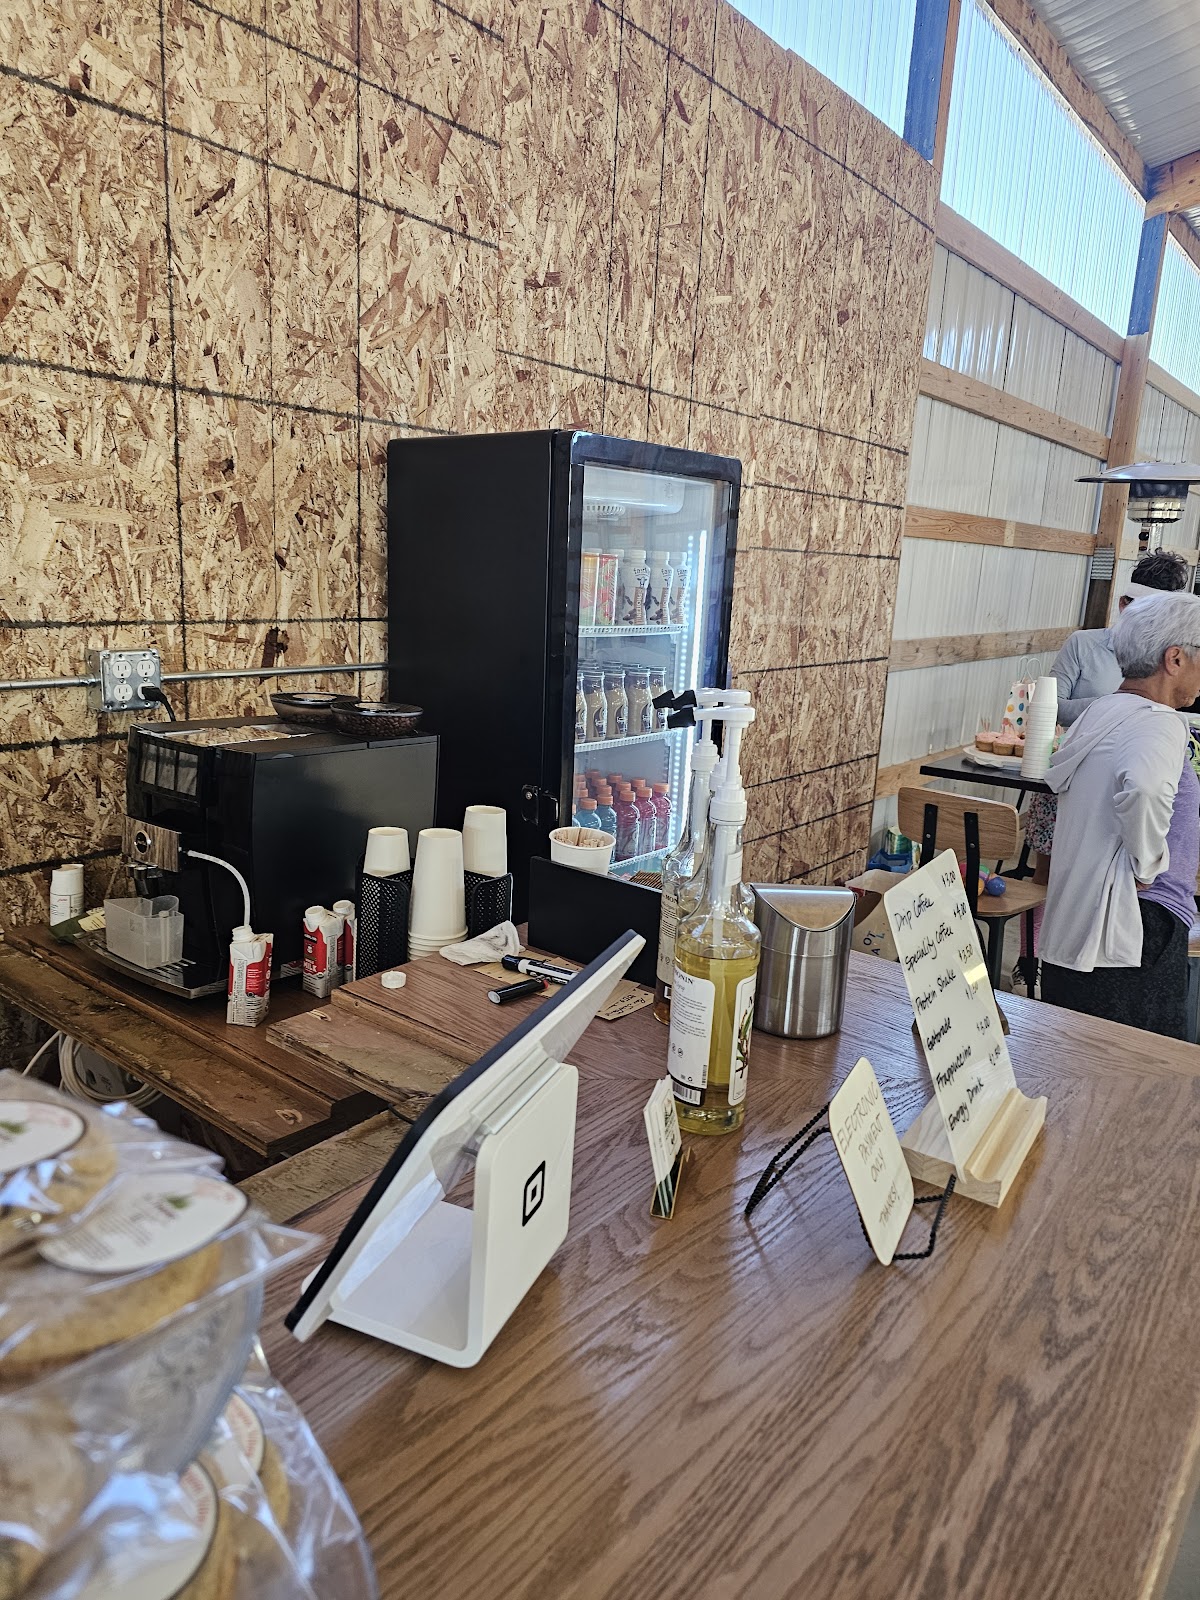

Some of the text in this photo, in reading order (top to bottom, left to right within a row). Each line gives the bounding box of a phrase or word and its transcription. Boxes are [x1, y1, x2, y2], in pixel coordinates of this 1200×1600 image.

[941, 870, 956, 888] $3.00
[894, 892, 935, 932] Drip Coffee
[935, 922, 954, 944] Coffee
[958, 943, 974, 964] $3.50
[915, 968, 956, 1016] Protein Shake
[926, 1016, 952, 1052] Gatorade
[936, 1044, 972, 1092] Frappuccino
[837, 1081, 879, 1155] ELECTRONIC
[948, 1076, 984, 1131] Energy Drink
[858, 1112, 884, 1165] PAYMENT
[870, 1147, 887, 1183] ONLY
[878, 1181, 900, 1228] THANKS!
